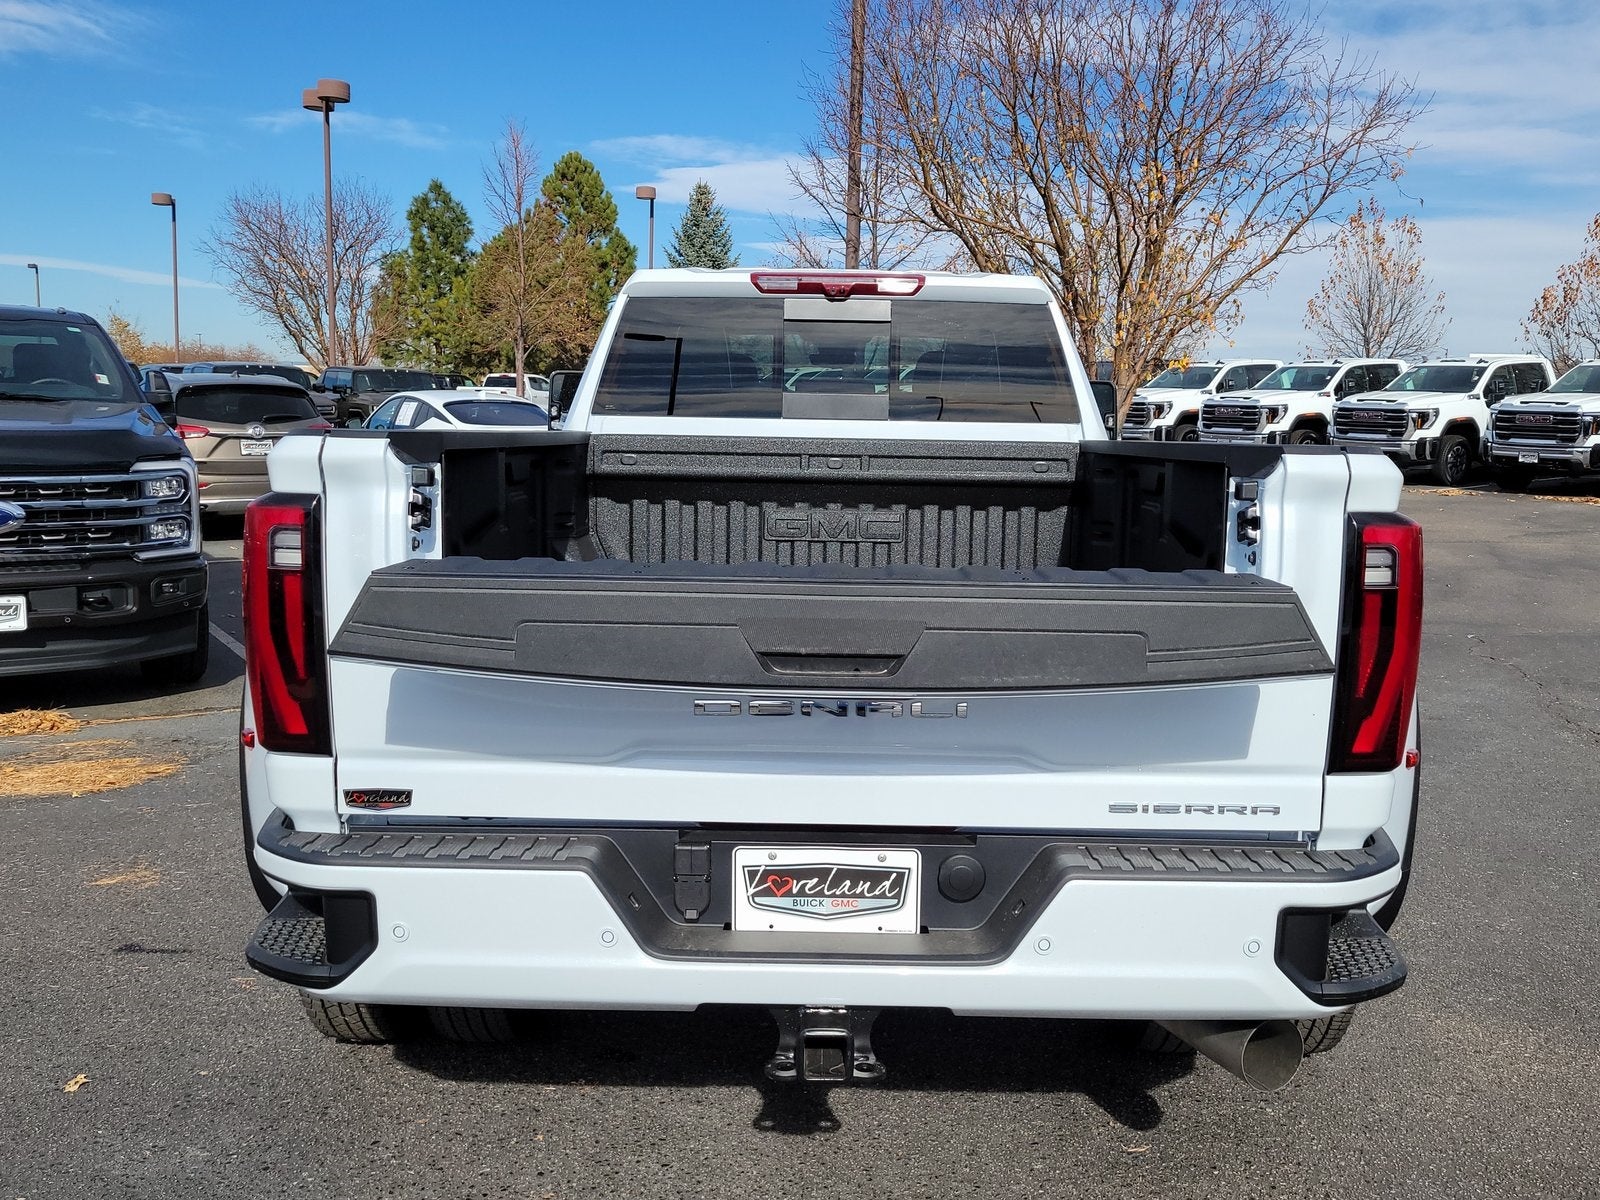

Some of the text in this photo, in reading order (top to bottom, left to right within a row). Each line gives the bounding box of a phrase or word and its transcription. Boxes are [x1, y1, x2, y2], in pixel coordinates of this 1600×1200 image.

[767, 511, 902, 539] GMC
[694, 700, 968, 717] DENALI
[1108, 803, 1281, 816] SIERRA
[747, 864, 900, 898] Loveland
[792, 898, 859, 908] BUICK GMC
